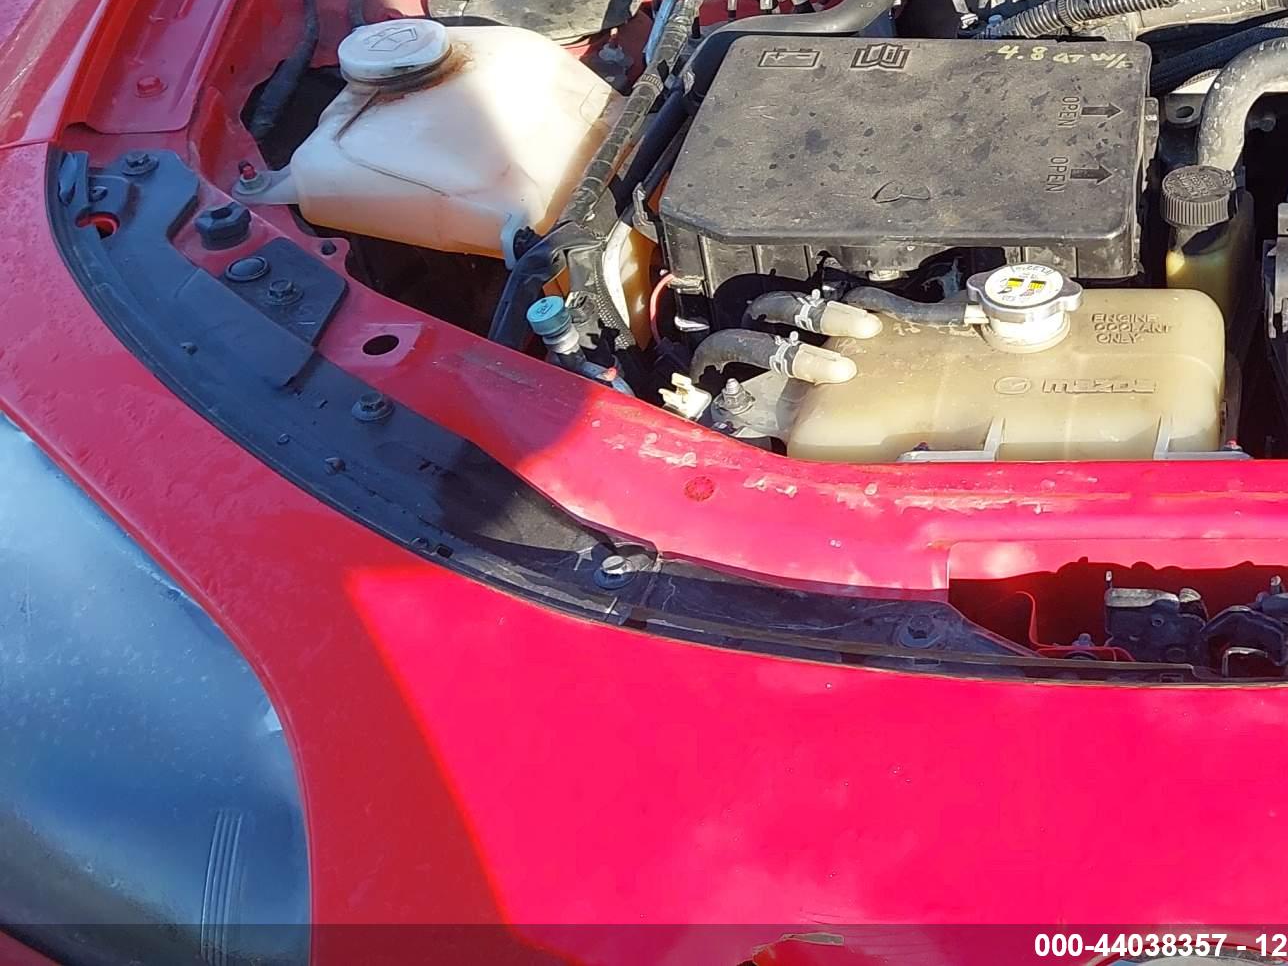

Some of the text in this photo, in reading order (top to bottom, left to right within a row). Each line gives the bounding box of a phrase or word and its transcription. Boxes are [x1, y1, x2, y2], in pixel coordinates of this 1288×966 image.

[998, 45, 1048, 61] 4.8
[1057, 96, 1081, 129] OPEN
[1045, 156, 1070, 193] OPEN
[1091, 313, 1159, 323] ENGINE
[1094, 322, 1172, 334] COOLANT
[1096, 333, 1141, 345] ONLY
